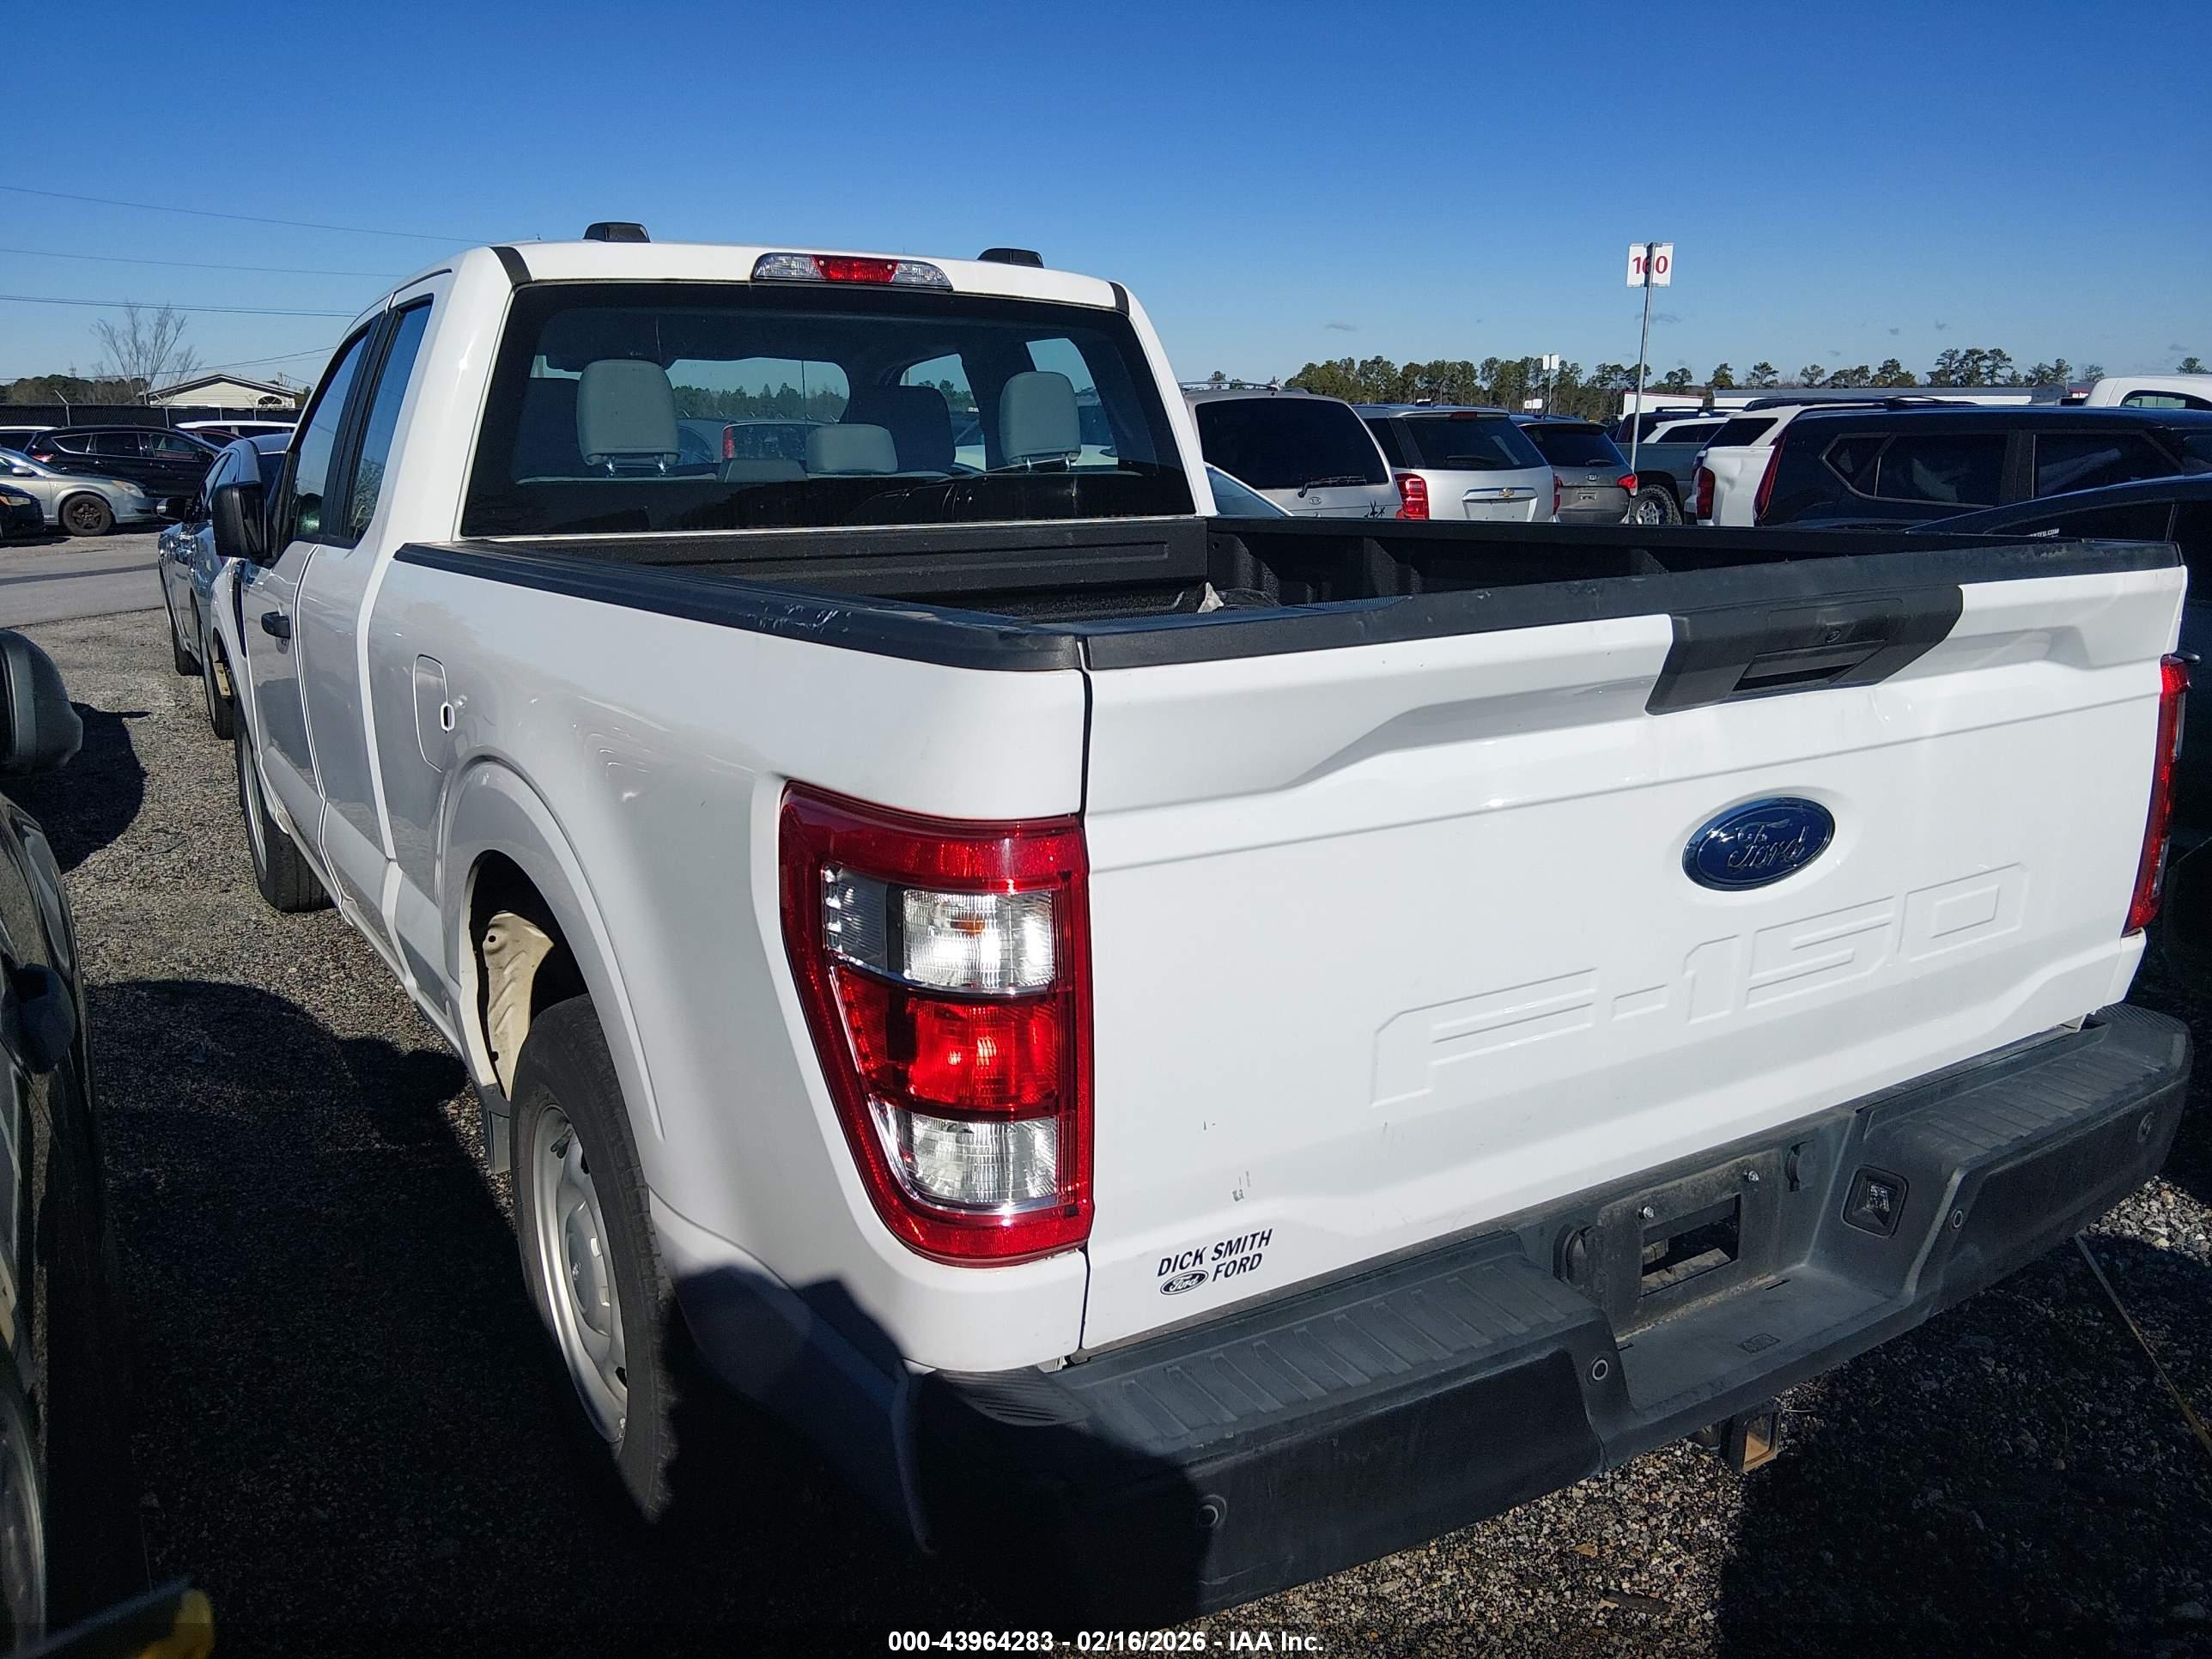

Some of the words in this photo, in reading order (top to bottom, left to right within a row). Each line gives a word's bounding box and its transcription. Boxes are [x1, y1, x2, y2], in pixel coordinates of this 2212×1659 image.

[1728, 818, 1809, 871] Ford
[1370, 863, 2028, 1106] F-150
[1157, 1246, 1208, 1277] DICK
[1212, 1228, 1273, 1261] SMITH
[1212, 1253, 1263, 1282] FORD
[1169, 1274, 1200, 1291] Ford
